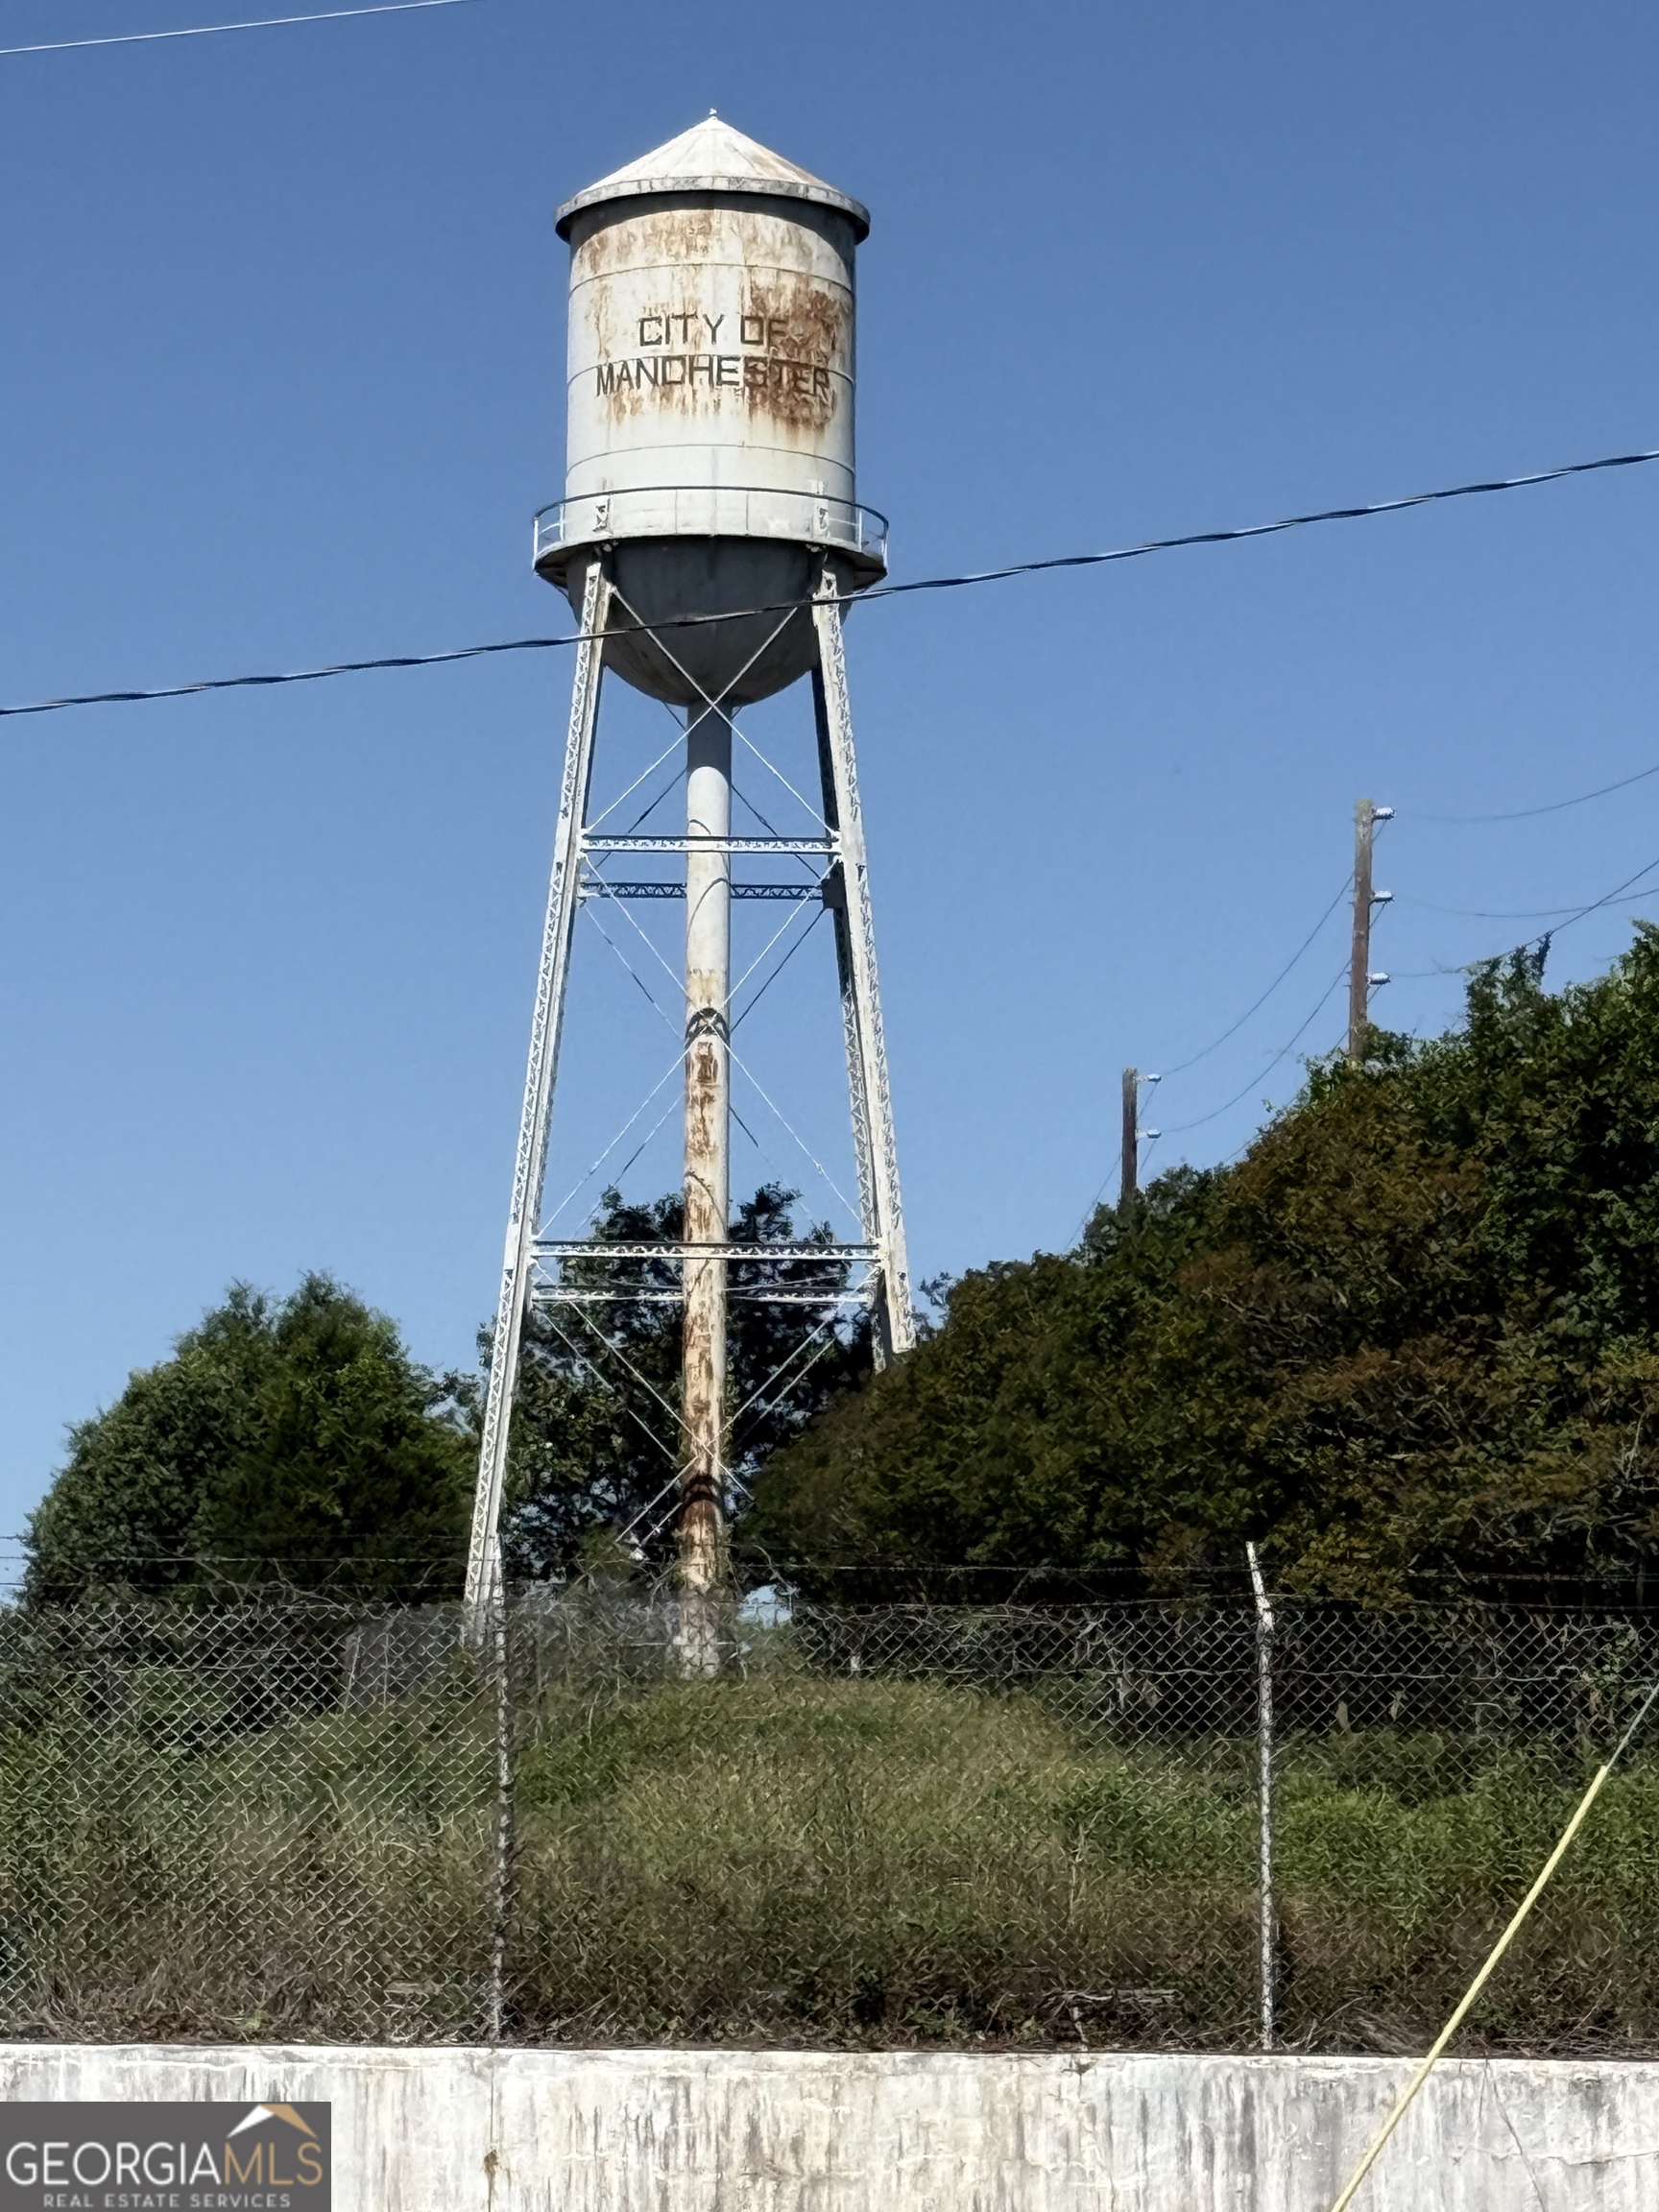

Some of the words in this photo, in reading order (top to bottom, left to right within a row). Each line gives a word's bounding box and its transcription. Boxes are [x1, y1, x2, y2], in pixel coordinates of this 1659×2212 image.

[638, 312, 725, 347] CITY
[740, 314, 789, 347] OF
[595, 354, 830, 397] MANCHESTER
